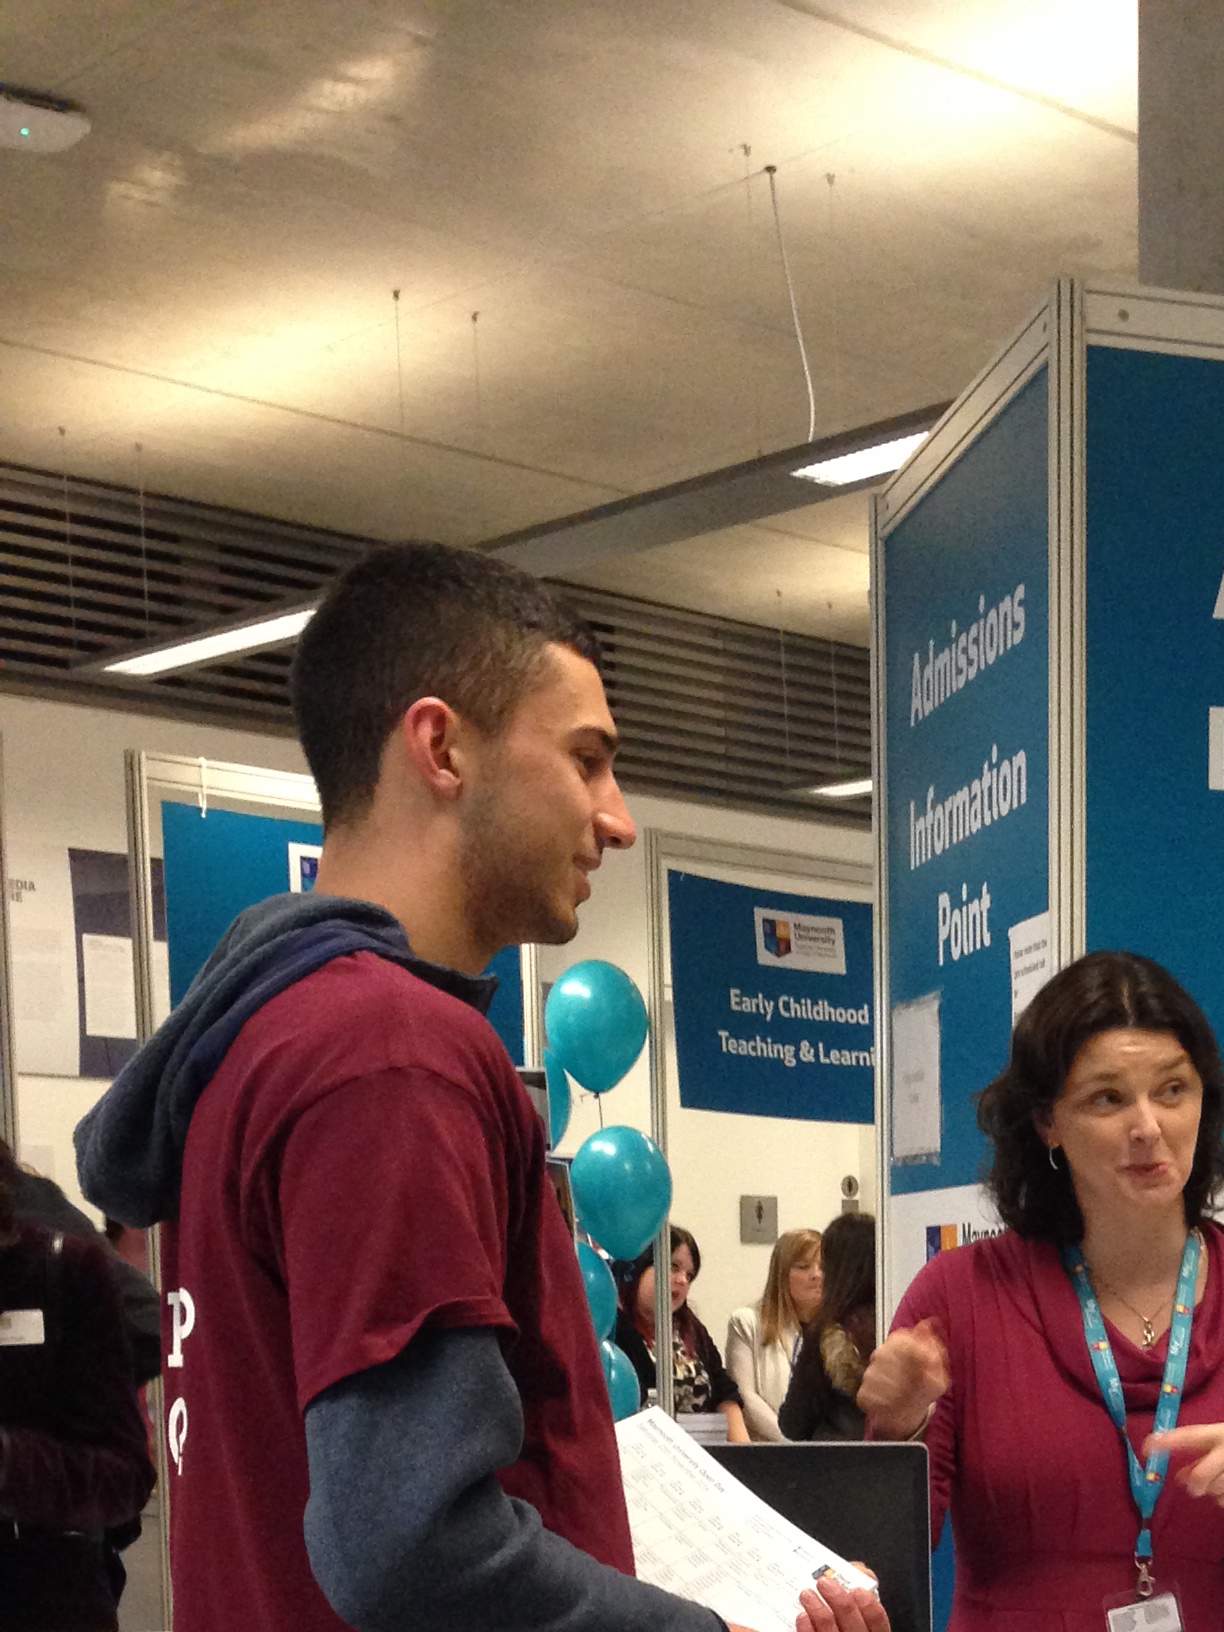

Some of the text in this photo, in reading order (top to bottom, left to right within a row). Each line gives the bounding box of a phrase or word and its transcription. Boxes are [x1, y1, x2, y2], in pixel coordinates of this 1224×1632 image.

[910, 583, 1027, 727] Admissions
[910, 743, 1027, 870] Information
[938, 882, 991, 966] Point
[718, 1029, 797, 1068] Teaching
[799, 1039, 815, 1063] &
[730, 988, 870, 1026] Early Childhood
